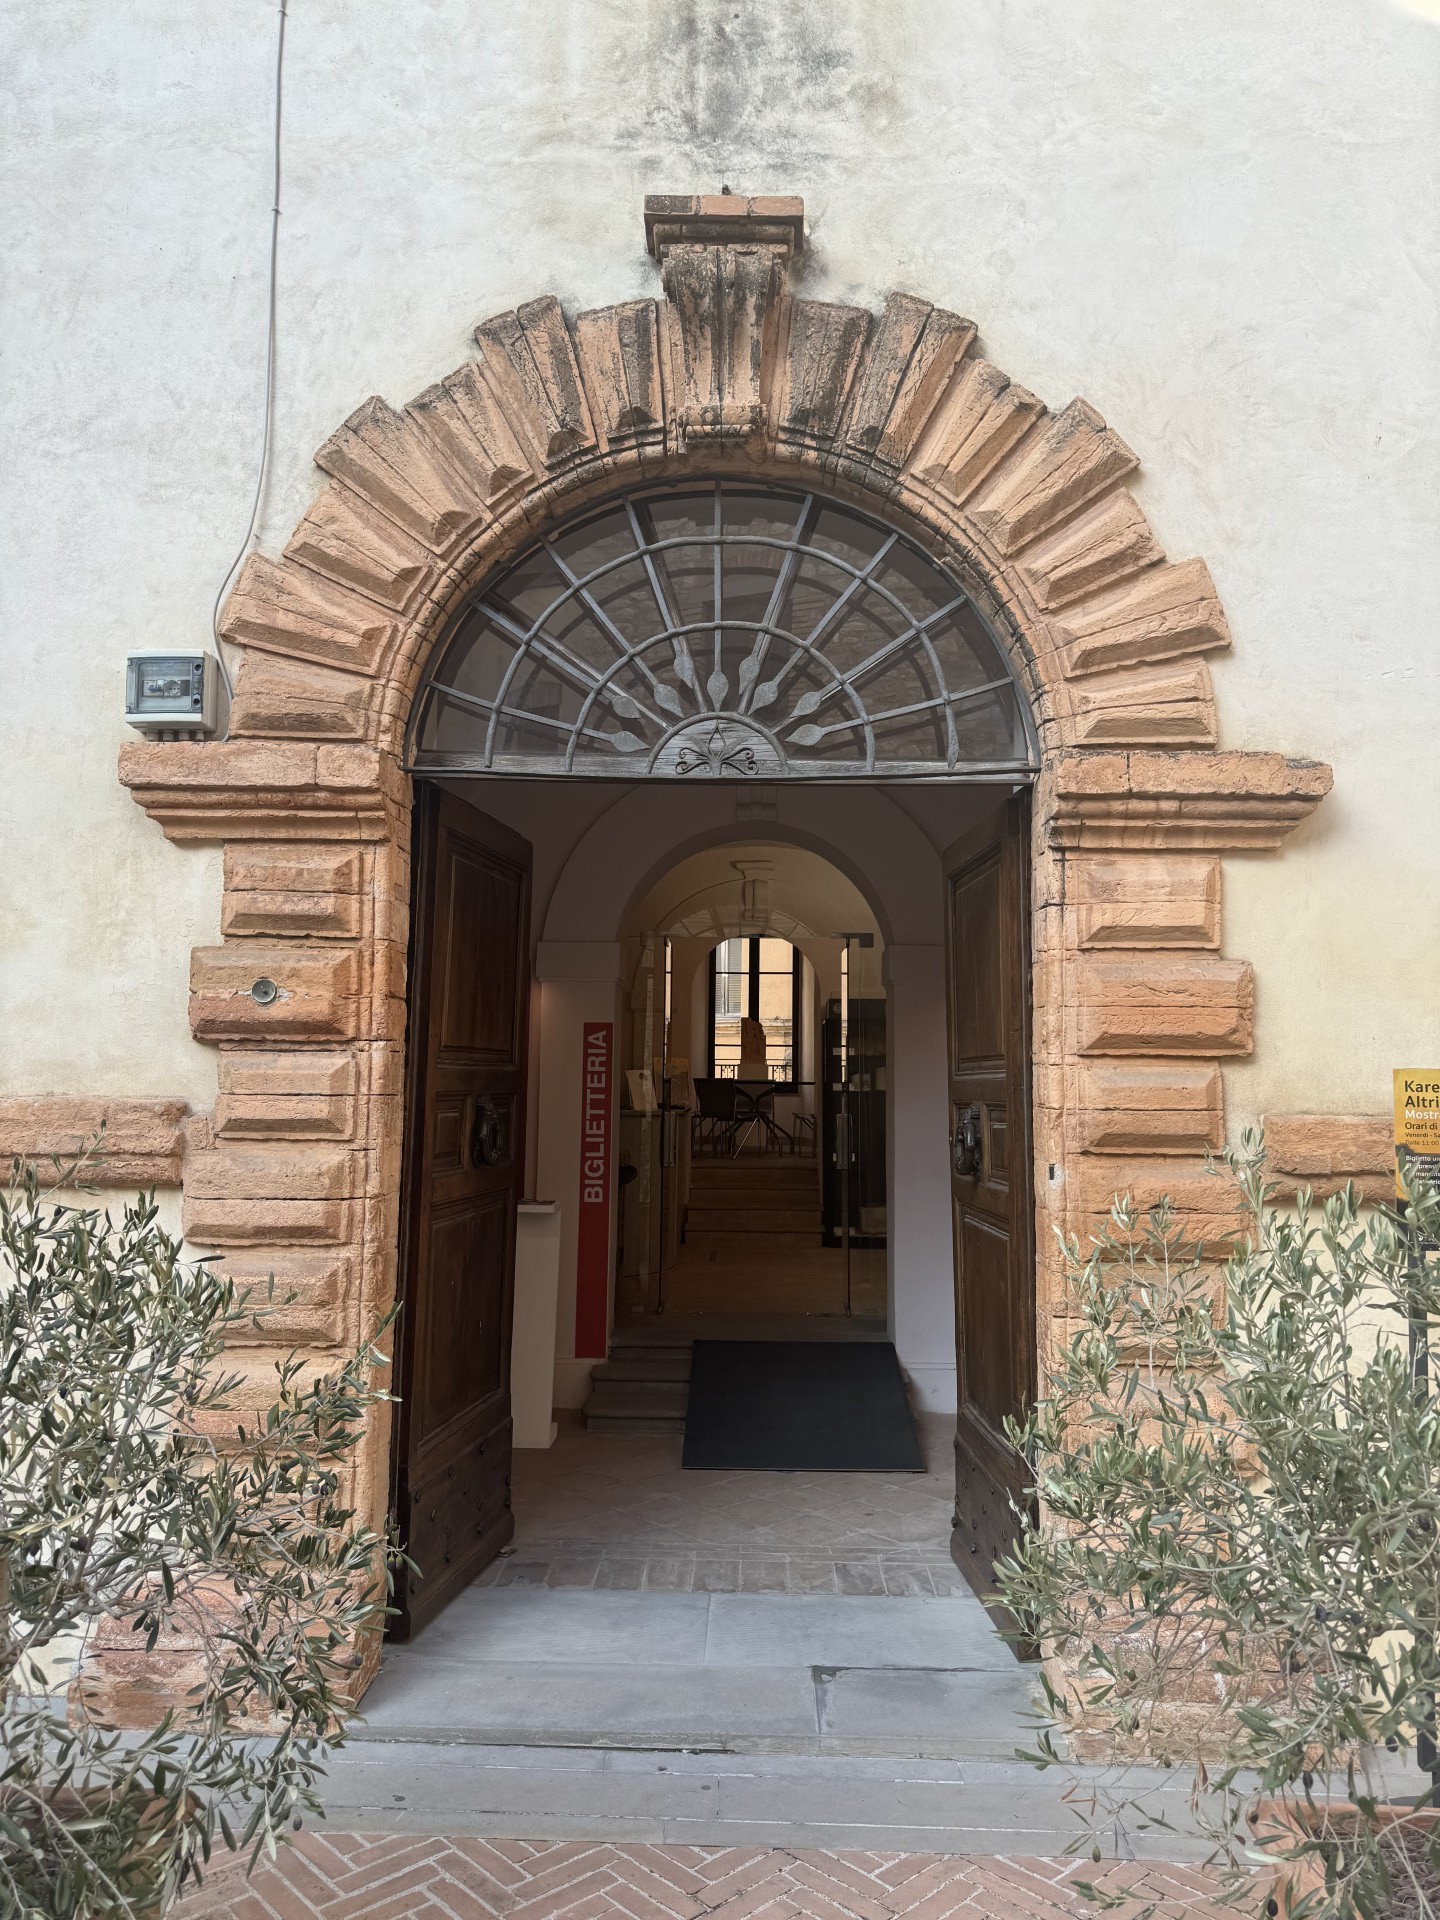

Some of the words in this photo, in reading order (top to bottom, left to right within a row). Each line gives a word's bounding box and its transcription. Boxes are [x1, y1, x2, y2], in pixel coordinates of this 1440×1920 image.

[1404, 1080, 1440, 1093] Kare
[1404, 1095, 1440, 1108] Altri
[584, 1030, 607, 1203] BIGLIETTERIA
[1405, 1109, 1440, 1120] Mostr
[1405, 1121, 1427, 1130] Orari
[1429, 1122, 1438, 1130] di
